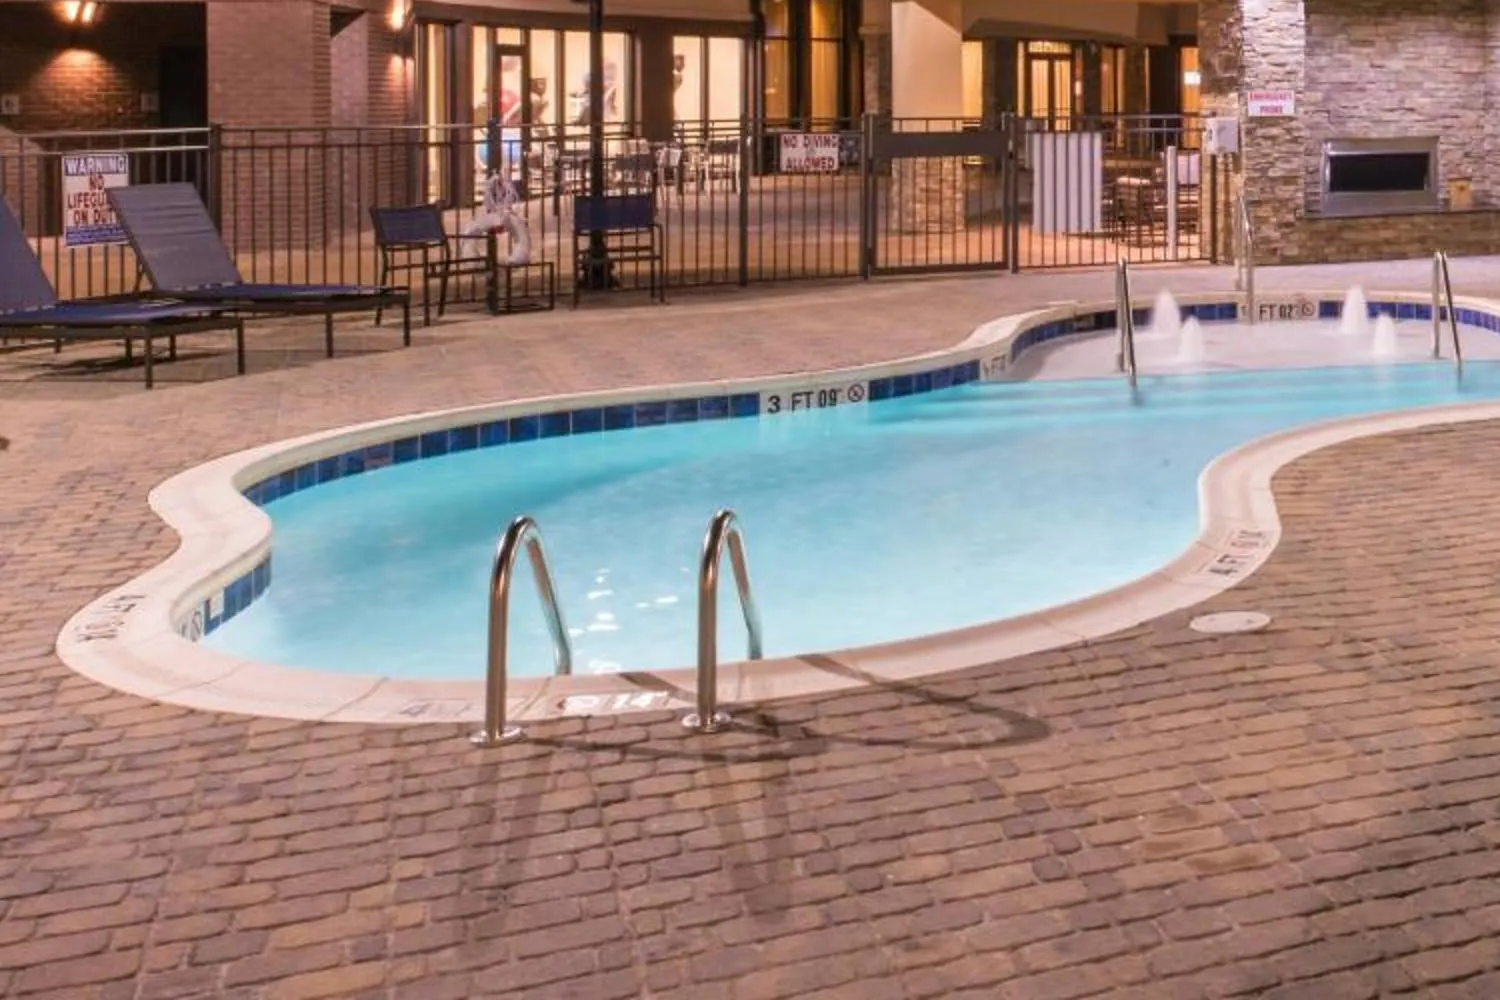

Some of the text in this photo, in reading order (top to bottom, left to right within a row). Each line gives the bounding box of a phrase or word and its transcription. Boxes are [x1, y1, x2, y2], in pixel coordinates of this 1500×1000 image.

[783, 135, 797, 148] NO
[65, 157, 127, 175] WARNING
[786, 156, 834, 169] ALLOWED
[89, 174, 104, 190] NO
[68, 191, 106, 208] LIFEGU
[74, 208, 117, 225] ON DUT
[1259, 303, 1276, 321] FT
[768, 395, 780, 414] 3
[792, 391, 814, 413] FT
